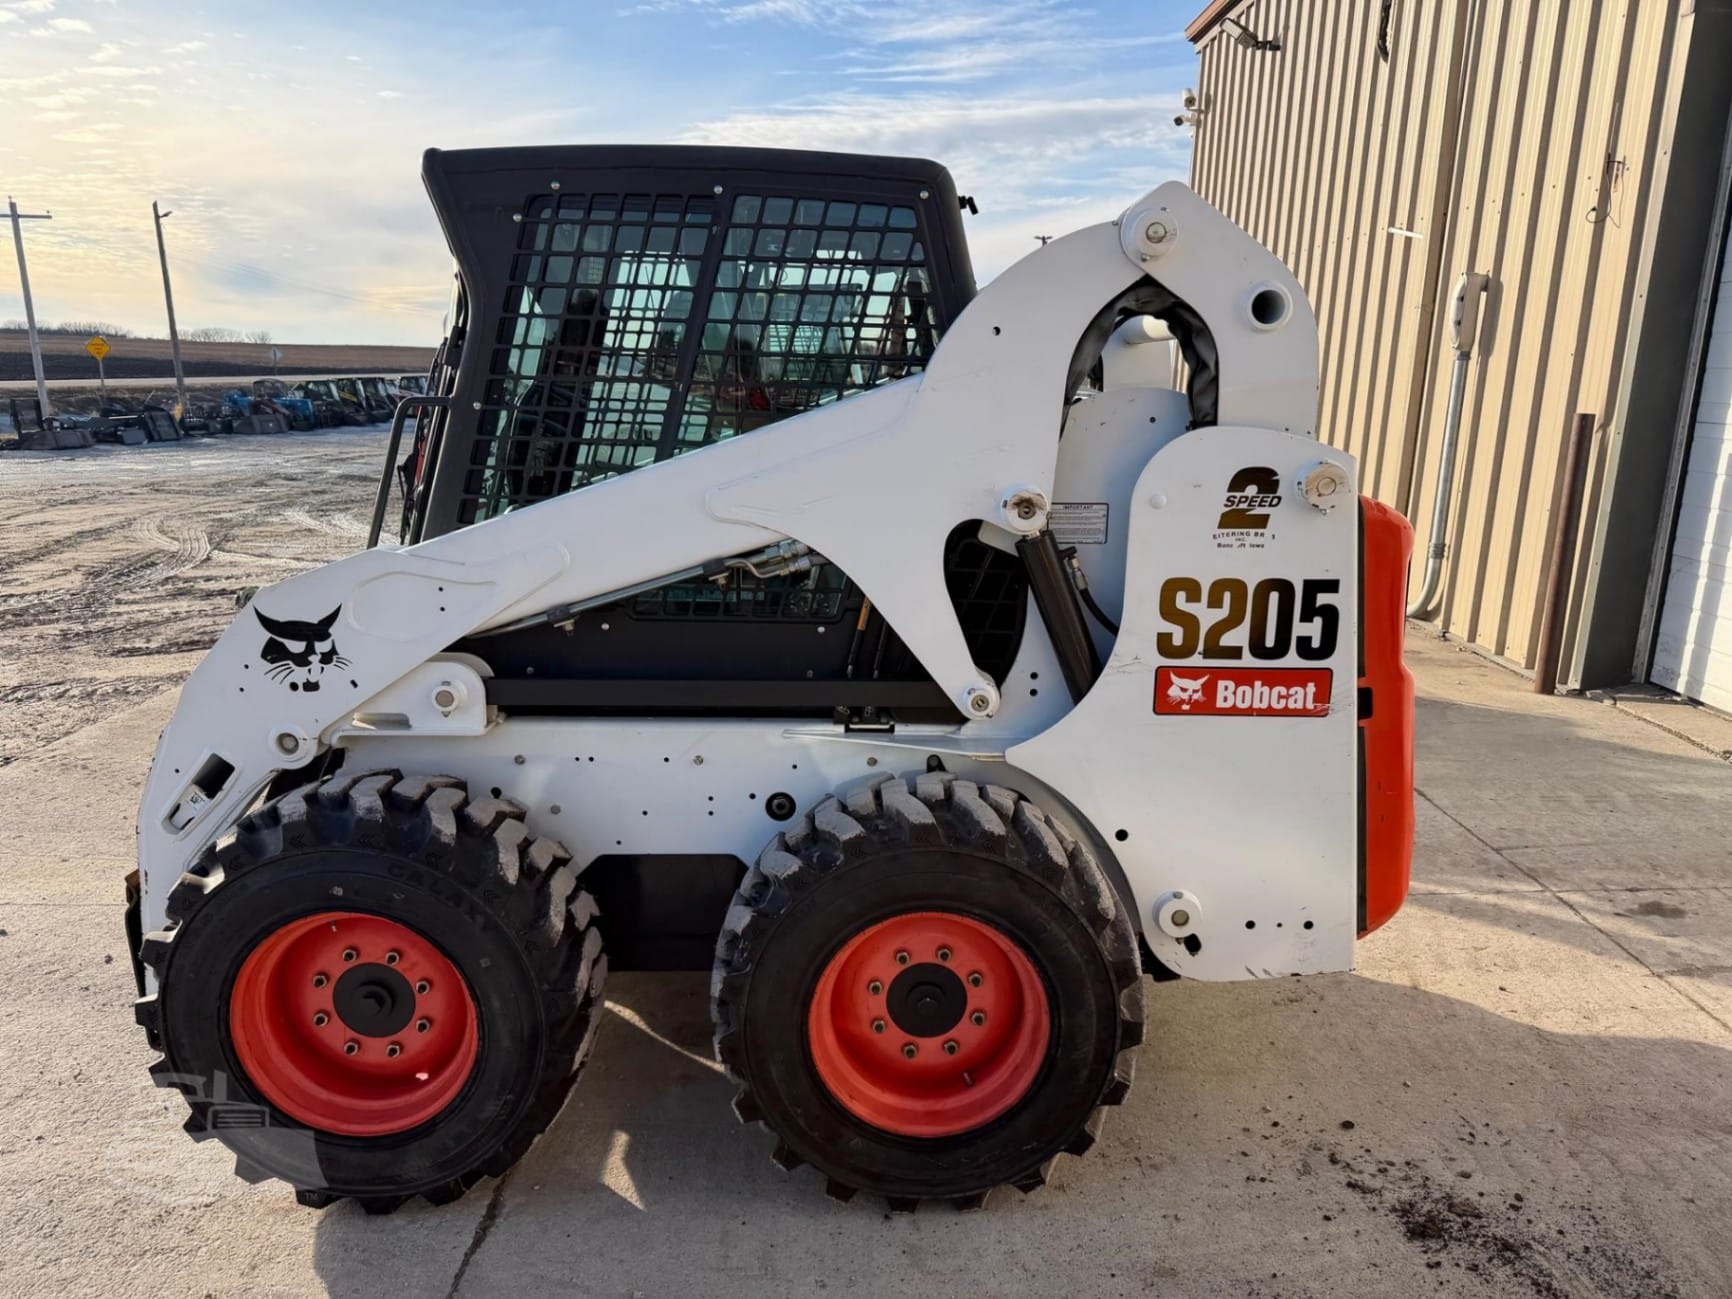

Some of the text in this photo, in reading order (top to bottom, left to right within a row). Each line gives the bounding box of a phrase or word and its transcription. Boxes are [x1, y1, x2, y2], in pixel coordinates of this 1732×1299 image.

[1217, 466, 1280, 529] 2
[1224, 495, 1282, 508] SPEED
[1156, 577, 1340, 660] S205
[1216, 679, 1317, 709] Bobcat
